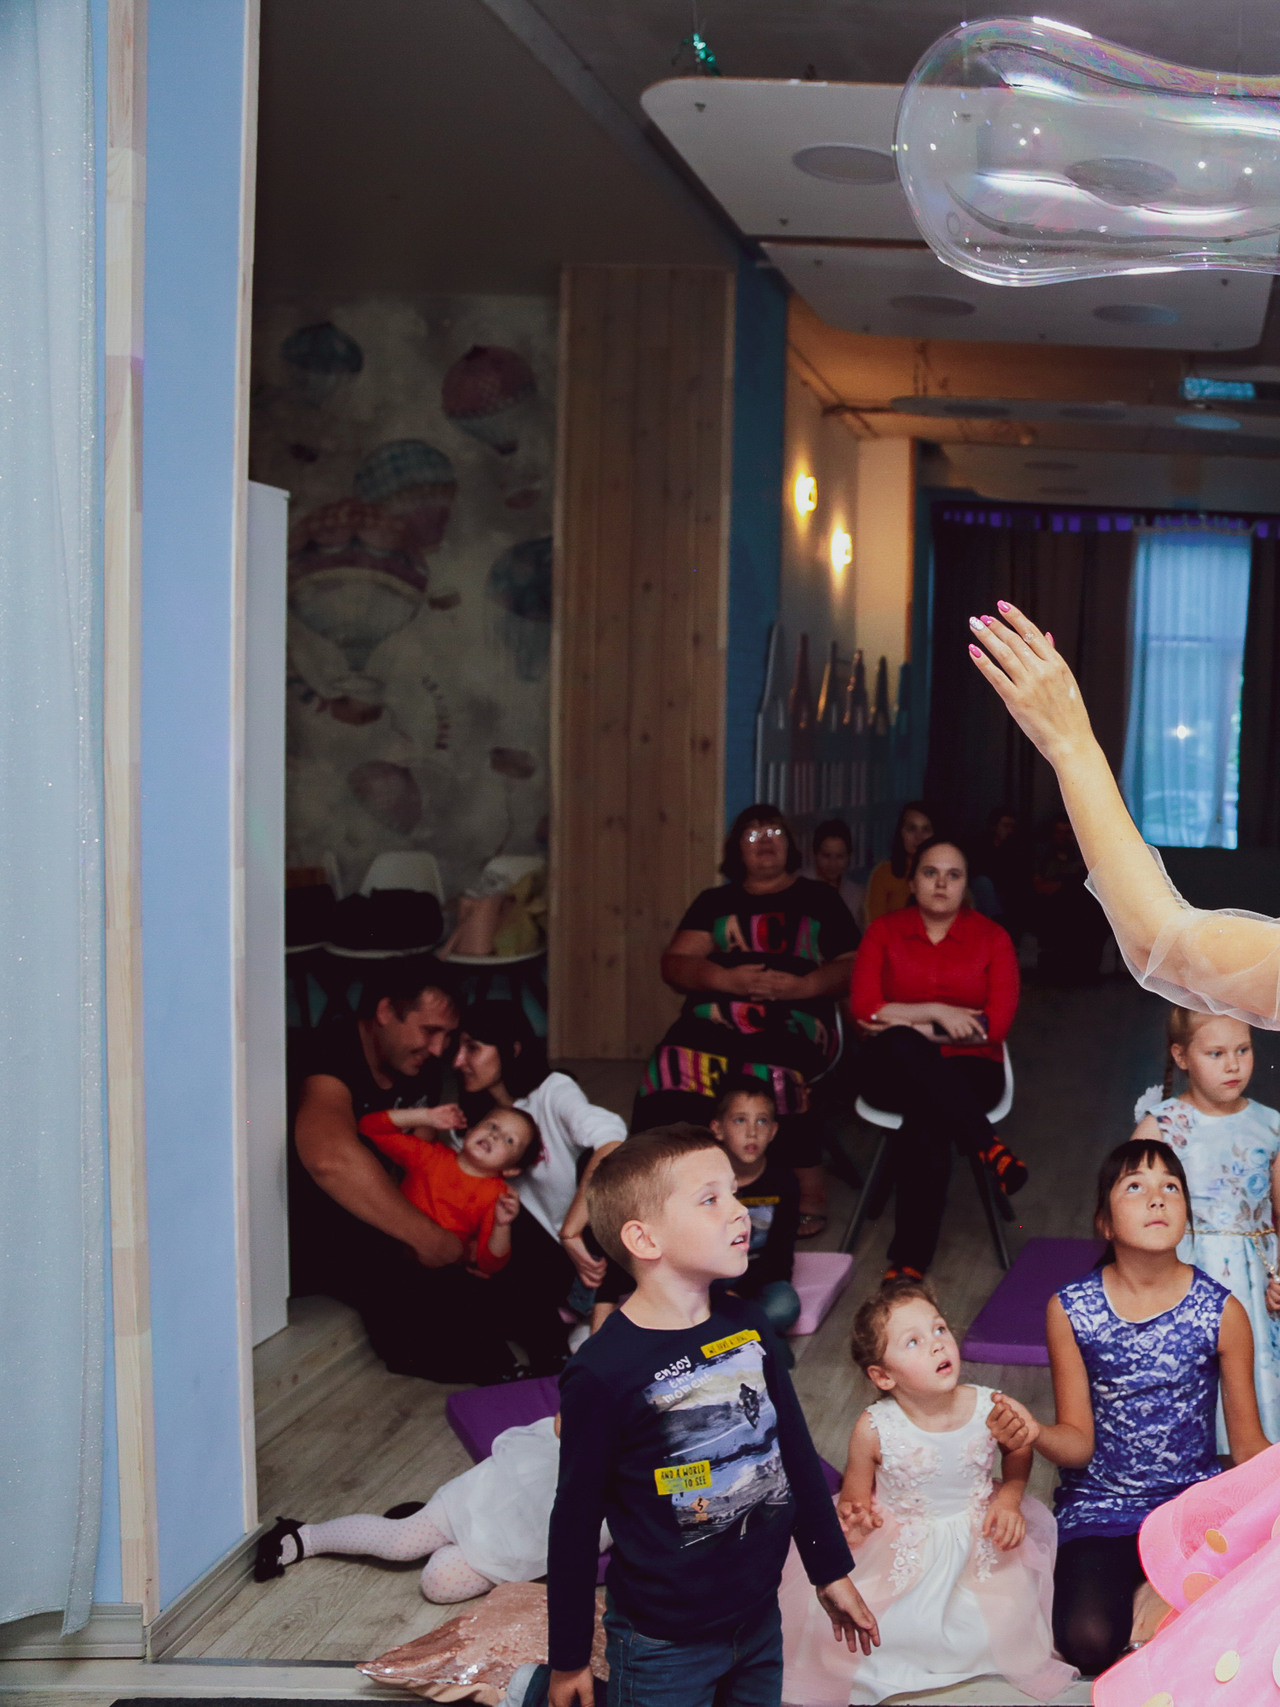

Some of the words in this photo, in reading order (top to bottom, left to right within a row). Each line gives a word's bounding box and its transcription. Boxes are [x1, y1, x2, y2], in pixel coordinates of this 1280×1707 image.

[654, 1355, 691, 1380] enjoy
[662, 1372, 712, 1403] moment
[669, 1370, 694, 1388] this
[661, 1470, 673, 1480] AND
[682, 1464, 705, 1476] WORLD
[685, 1478, 693, 1488] TO
[695, 1475, 706, 1486] SEE
